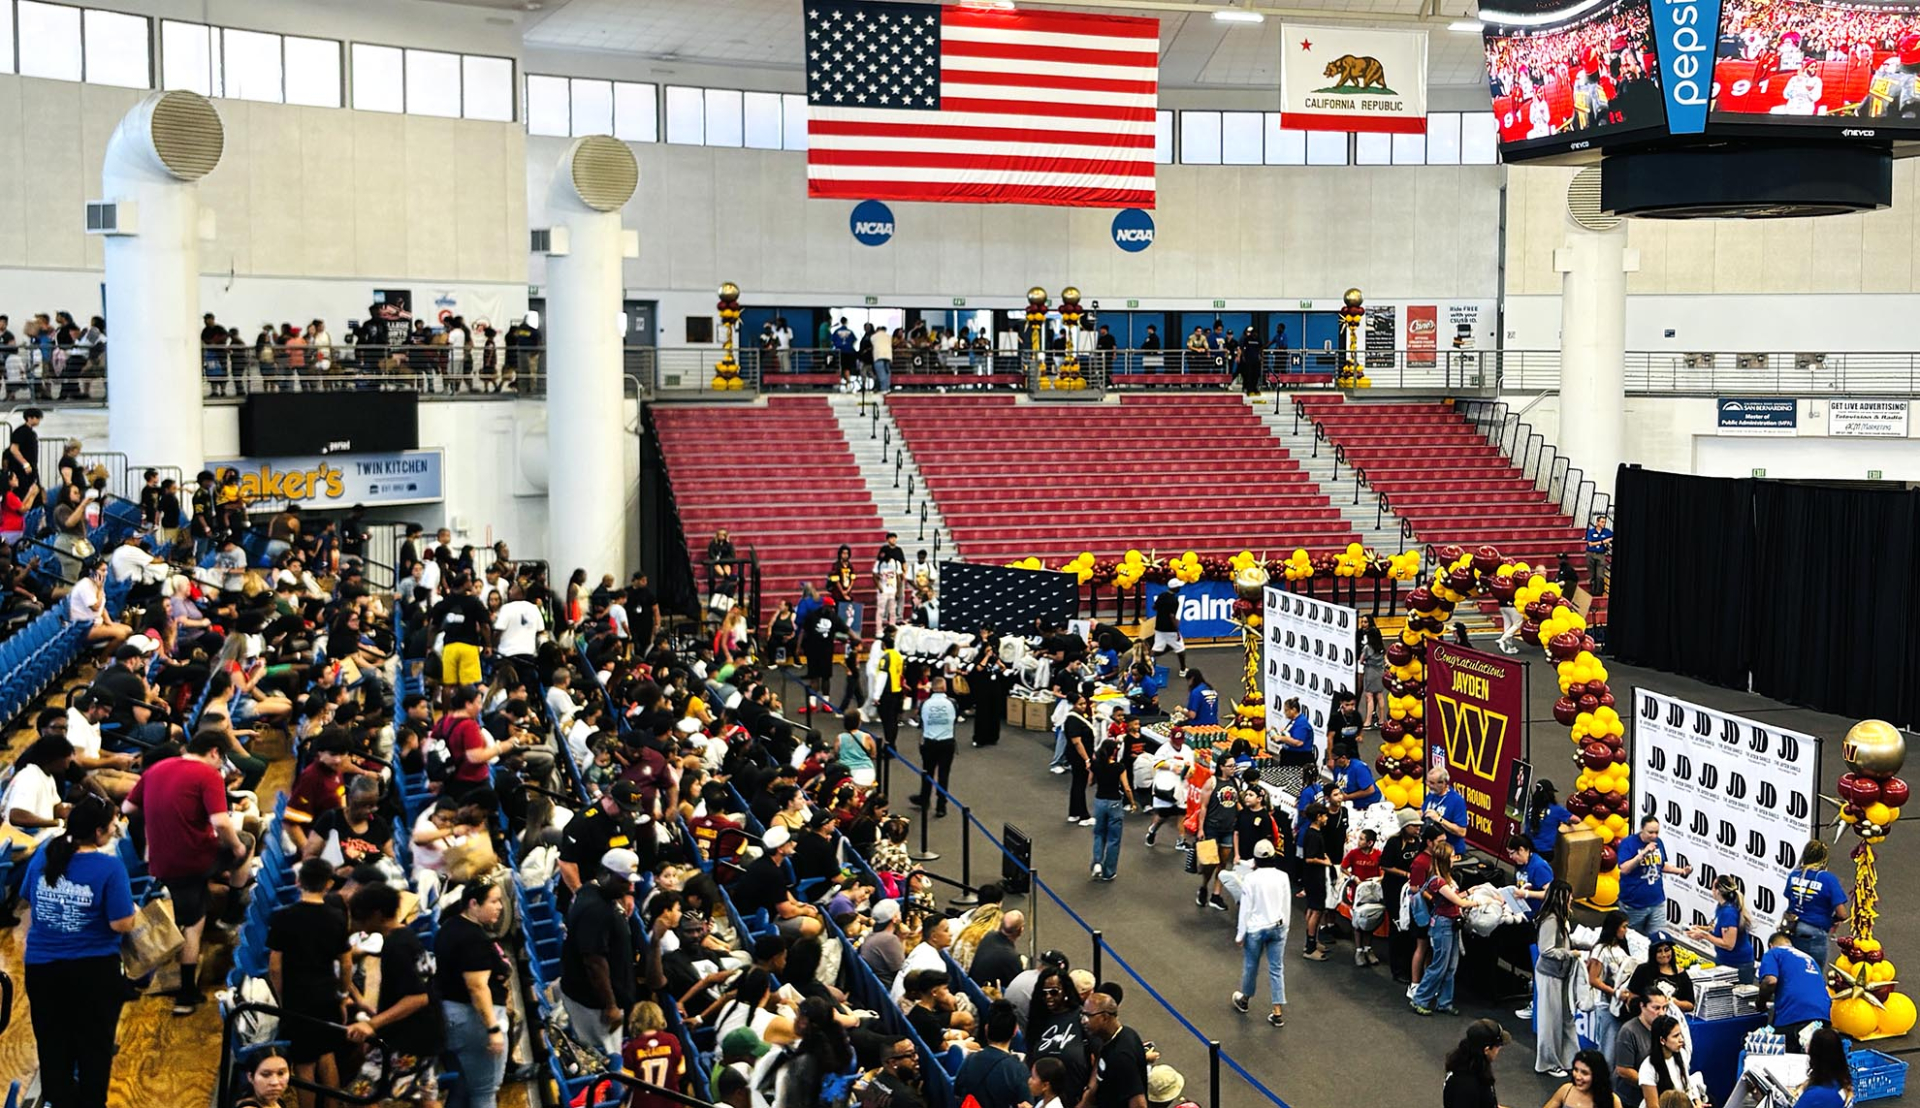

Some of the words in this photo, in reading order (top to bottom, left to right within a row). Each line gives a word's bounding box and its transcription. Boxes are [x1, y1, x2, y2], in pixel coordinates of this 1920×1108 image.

[1665, 0, 1707, 105] pepsi
[1305, 98, 1355, 110] CALIFORNIA
[1361, 100, 1403, 111] REPUBLIC
[855, 221, 893, 235] NCAA
[1116, 229, 1153, 242] NCAA
[1216, 356, 1223, 366] G
[1293, 356, 1300, 365] H
[357, 462, 382, 475] TWIN
[386, 460, 427, 473] KITCHEN
[1434, 645, 1505, 678] Congratulations
[1451, 670, 1489, 701] JAYDEN
[1641, 695, 1658, 720] JD
[1666, 702, 1684, 728] JD
[1693, 710, 1711, 736] JD
[1720, 719, 1740, 745] JD
[1749, 726, 1768, 753] JD
[1778, 735, 1799, 762] JD
[1648, 746, 1665, 772] JD
[1673, 754, 1691, 780] JD
[1698, 763, 1718, 789] JD
[1726, 771, 1746, 799] JD
[1466, 786, 1491, 811] ROUND
[1642, 791, 1657, 815] JD
[1756, 780, 1777, 809] JD
[1786, 790, 1808, 819] JD
[1476, 815, 1493, 836] PICK
[1665, 800, 1682, 826] JD
[1690, 809, 1708, 837] JD
[1716, 819, 1736, 847] JD
[1745, 830, 1766, 858] JD
[1775, 840, 1796, 869] JD
[1697, 863, 1717, 890] JD
[1754, 885, 1775, 914] JD
[641, 1058, 669, 1088] 17
